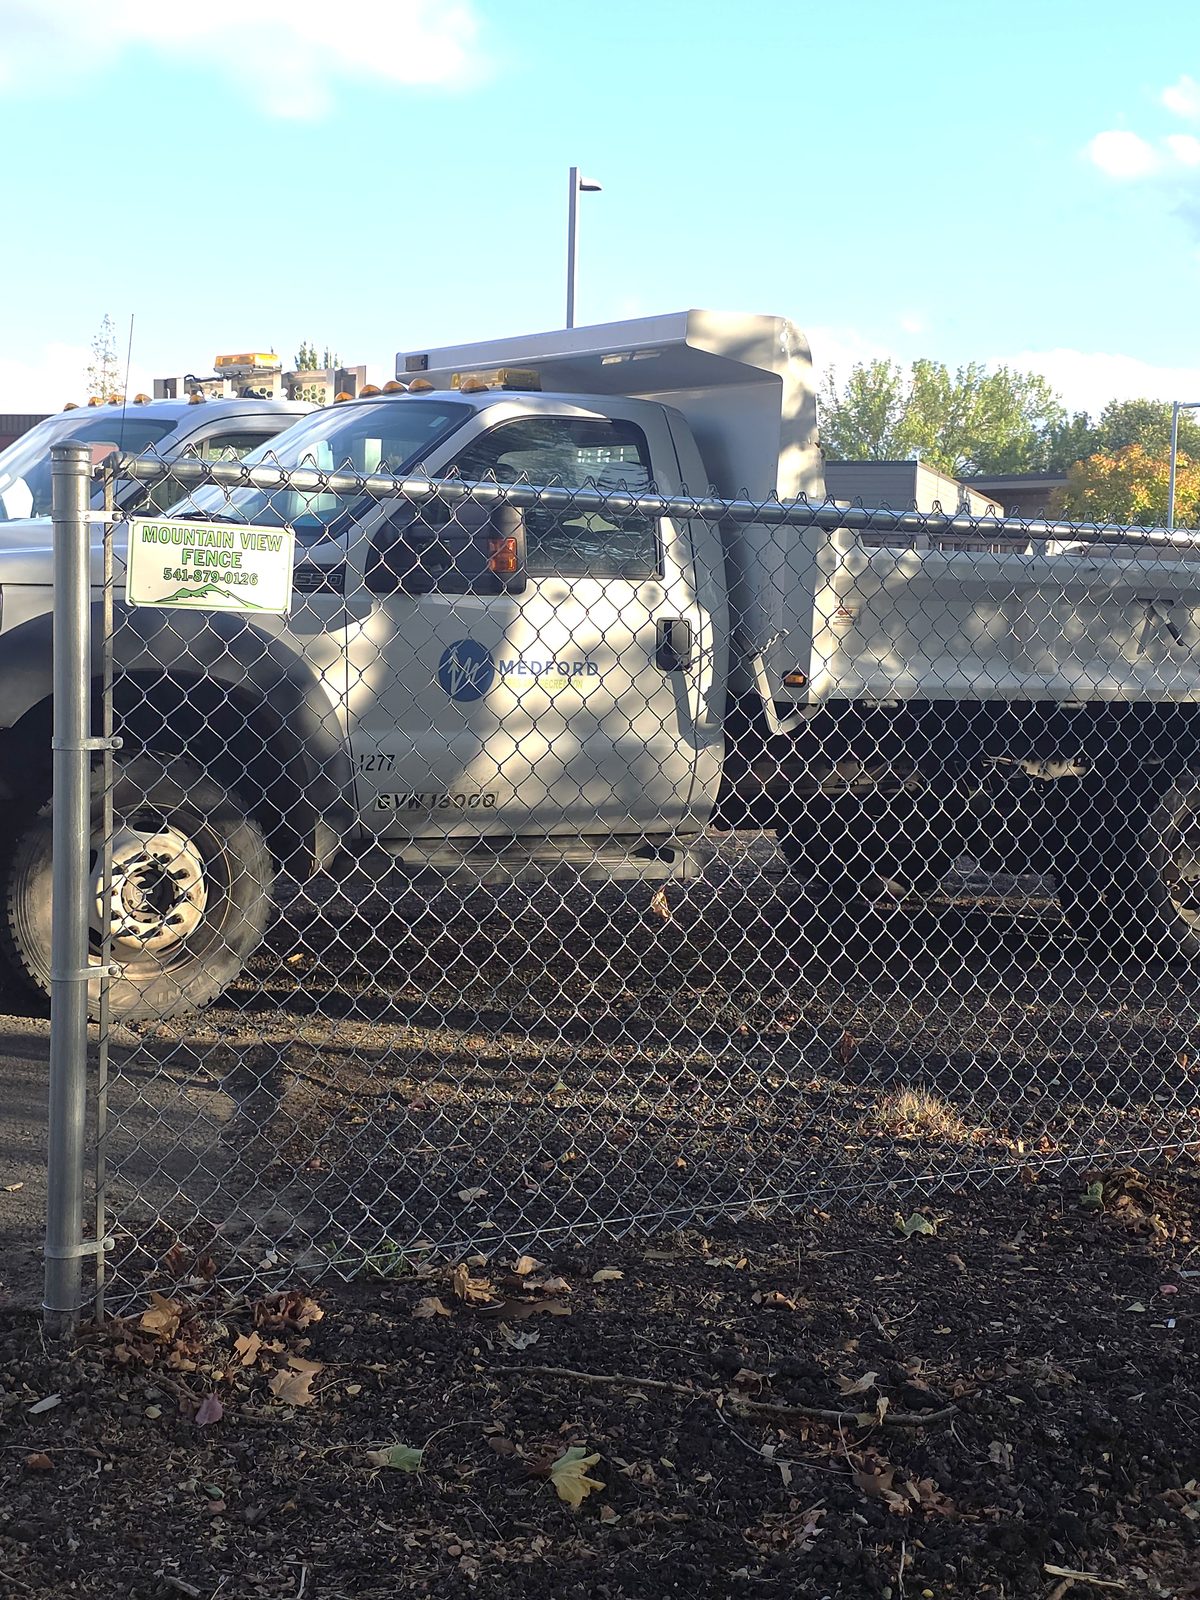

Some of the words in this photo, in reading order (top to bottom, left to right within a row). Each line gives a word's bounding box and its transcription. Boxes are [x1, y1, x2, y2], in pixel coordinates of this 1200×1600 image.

[142, 526, 234, 548] MOUNTAIN
[240, 533, 283, 551] VIEW
[181, 548, 243, 568] FENCE
[163, 568, 258, 585] 541-879-0126
[499, 660, 599, 676] MEDFORD
[360, 754, 395, 771] 1277
[377, 793, 424, 809] GVW
